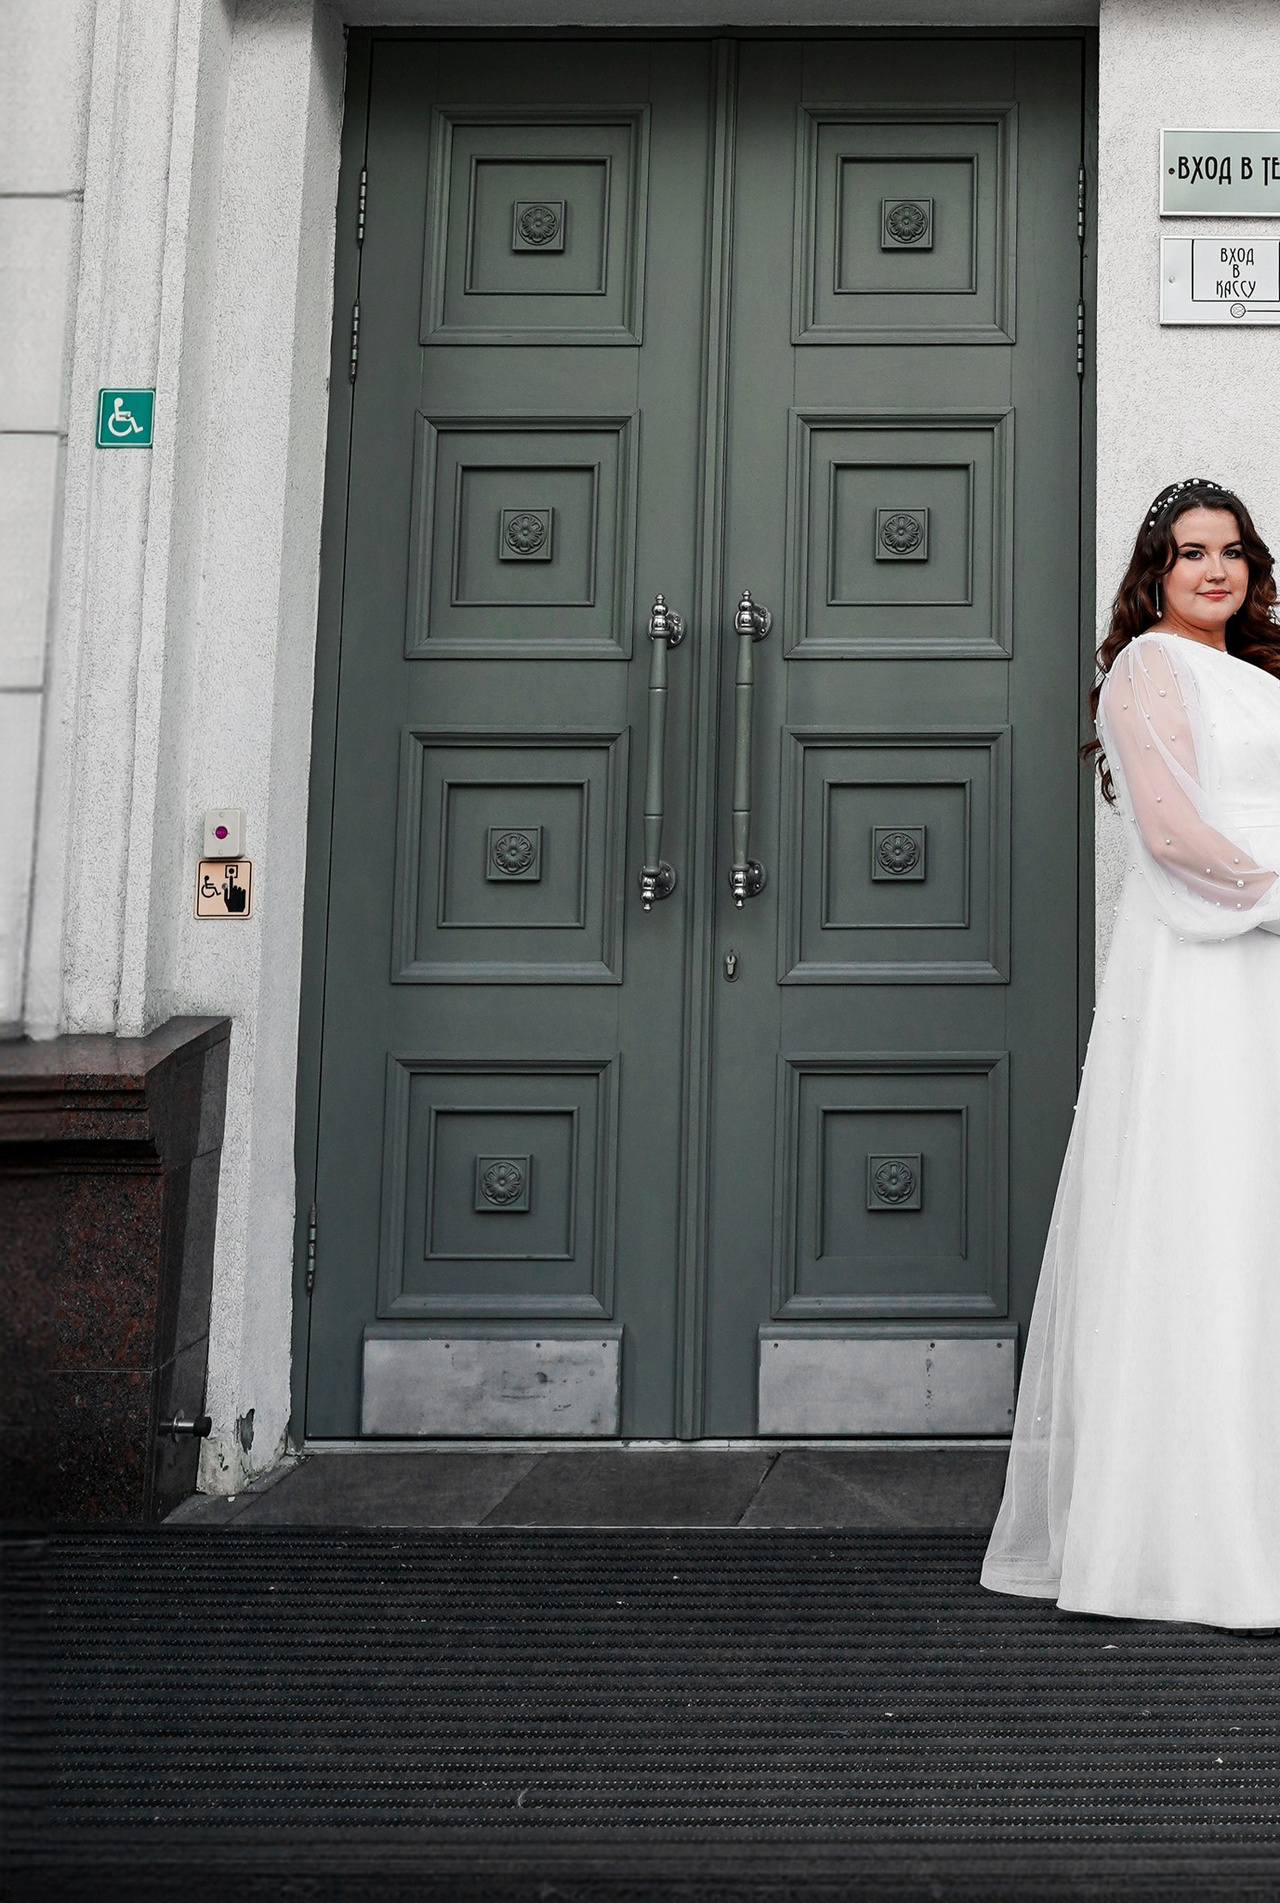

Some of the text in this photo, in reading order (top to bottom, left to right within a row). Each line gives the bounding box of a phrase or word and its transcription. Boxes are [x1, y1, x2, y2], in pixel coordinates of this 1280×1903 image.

[1179, 157, 1231, 185] ВХОД
[1242, 157, 1252, 179] В
[1221, 248, 1254, 266] ВХОД
[1233, 264, 1240, 278] В
[1217, 281, 1256, 298] КАССУ
